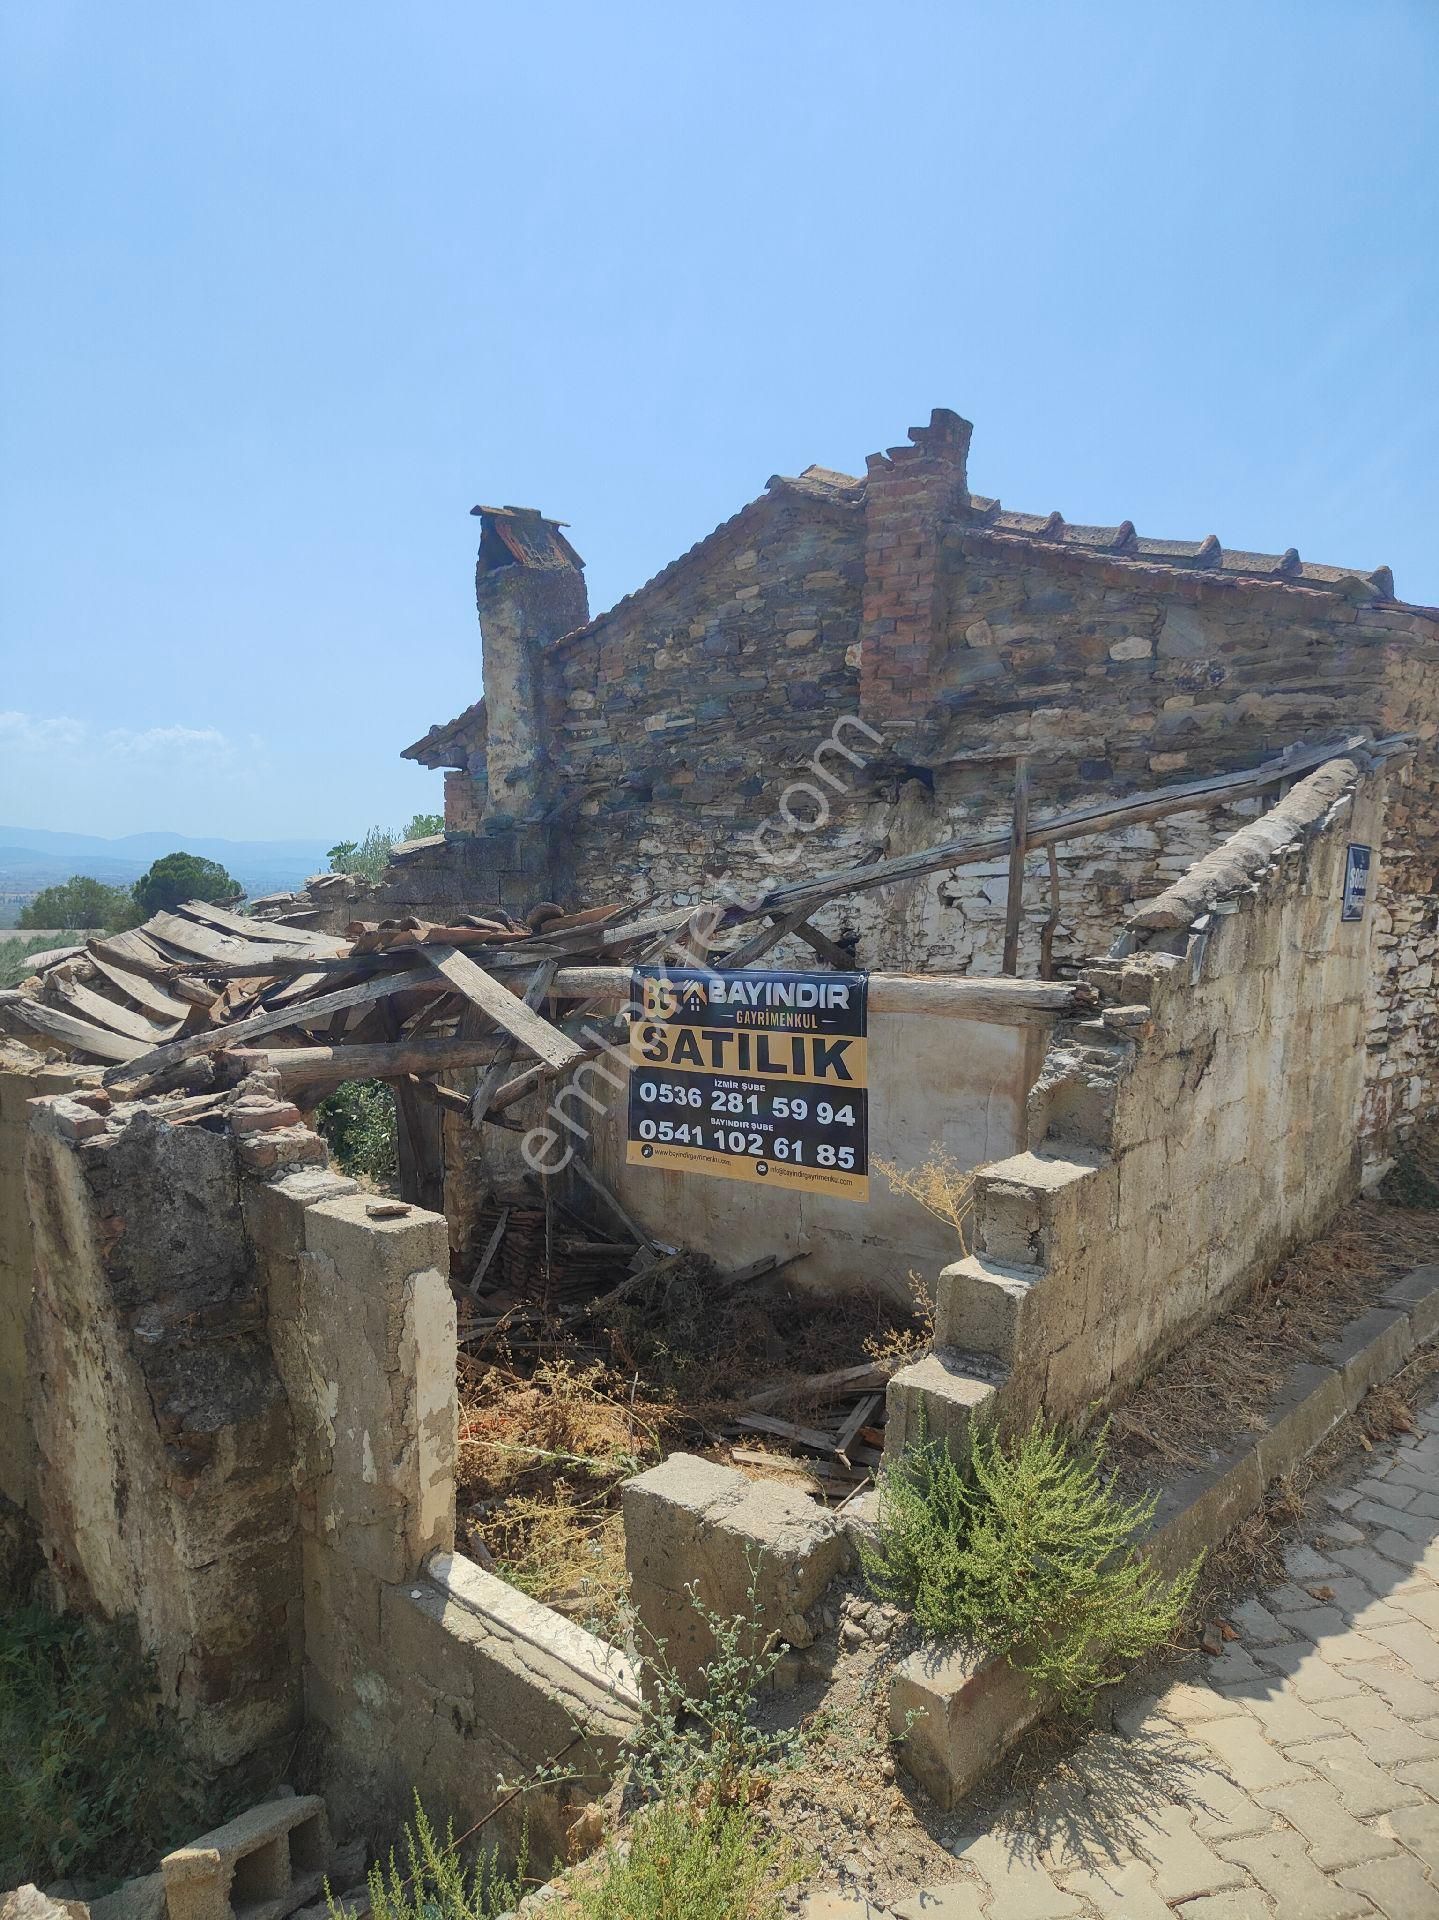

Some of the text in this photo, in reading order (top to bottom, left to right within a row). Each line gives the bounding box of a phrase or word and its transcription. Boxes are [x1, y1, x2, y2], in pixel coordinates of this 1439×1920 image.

[708, 979, 850, 1010] BAYINDIR
[736, 1008, 818, 1029] GAYRİMENKUL
[641, 1025, 854, 1081] SATILIK
[714, 1078, 766, 1092] İZMİR ŞUBE
[639, 1082, 856, 1127] 0536 281 59 94
[711, 1118, 774, 1132] BAYINDIR ŞUBE
[639, 1119, 855, 1169] 0541 102 61 85
